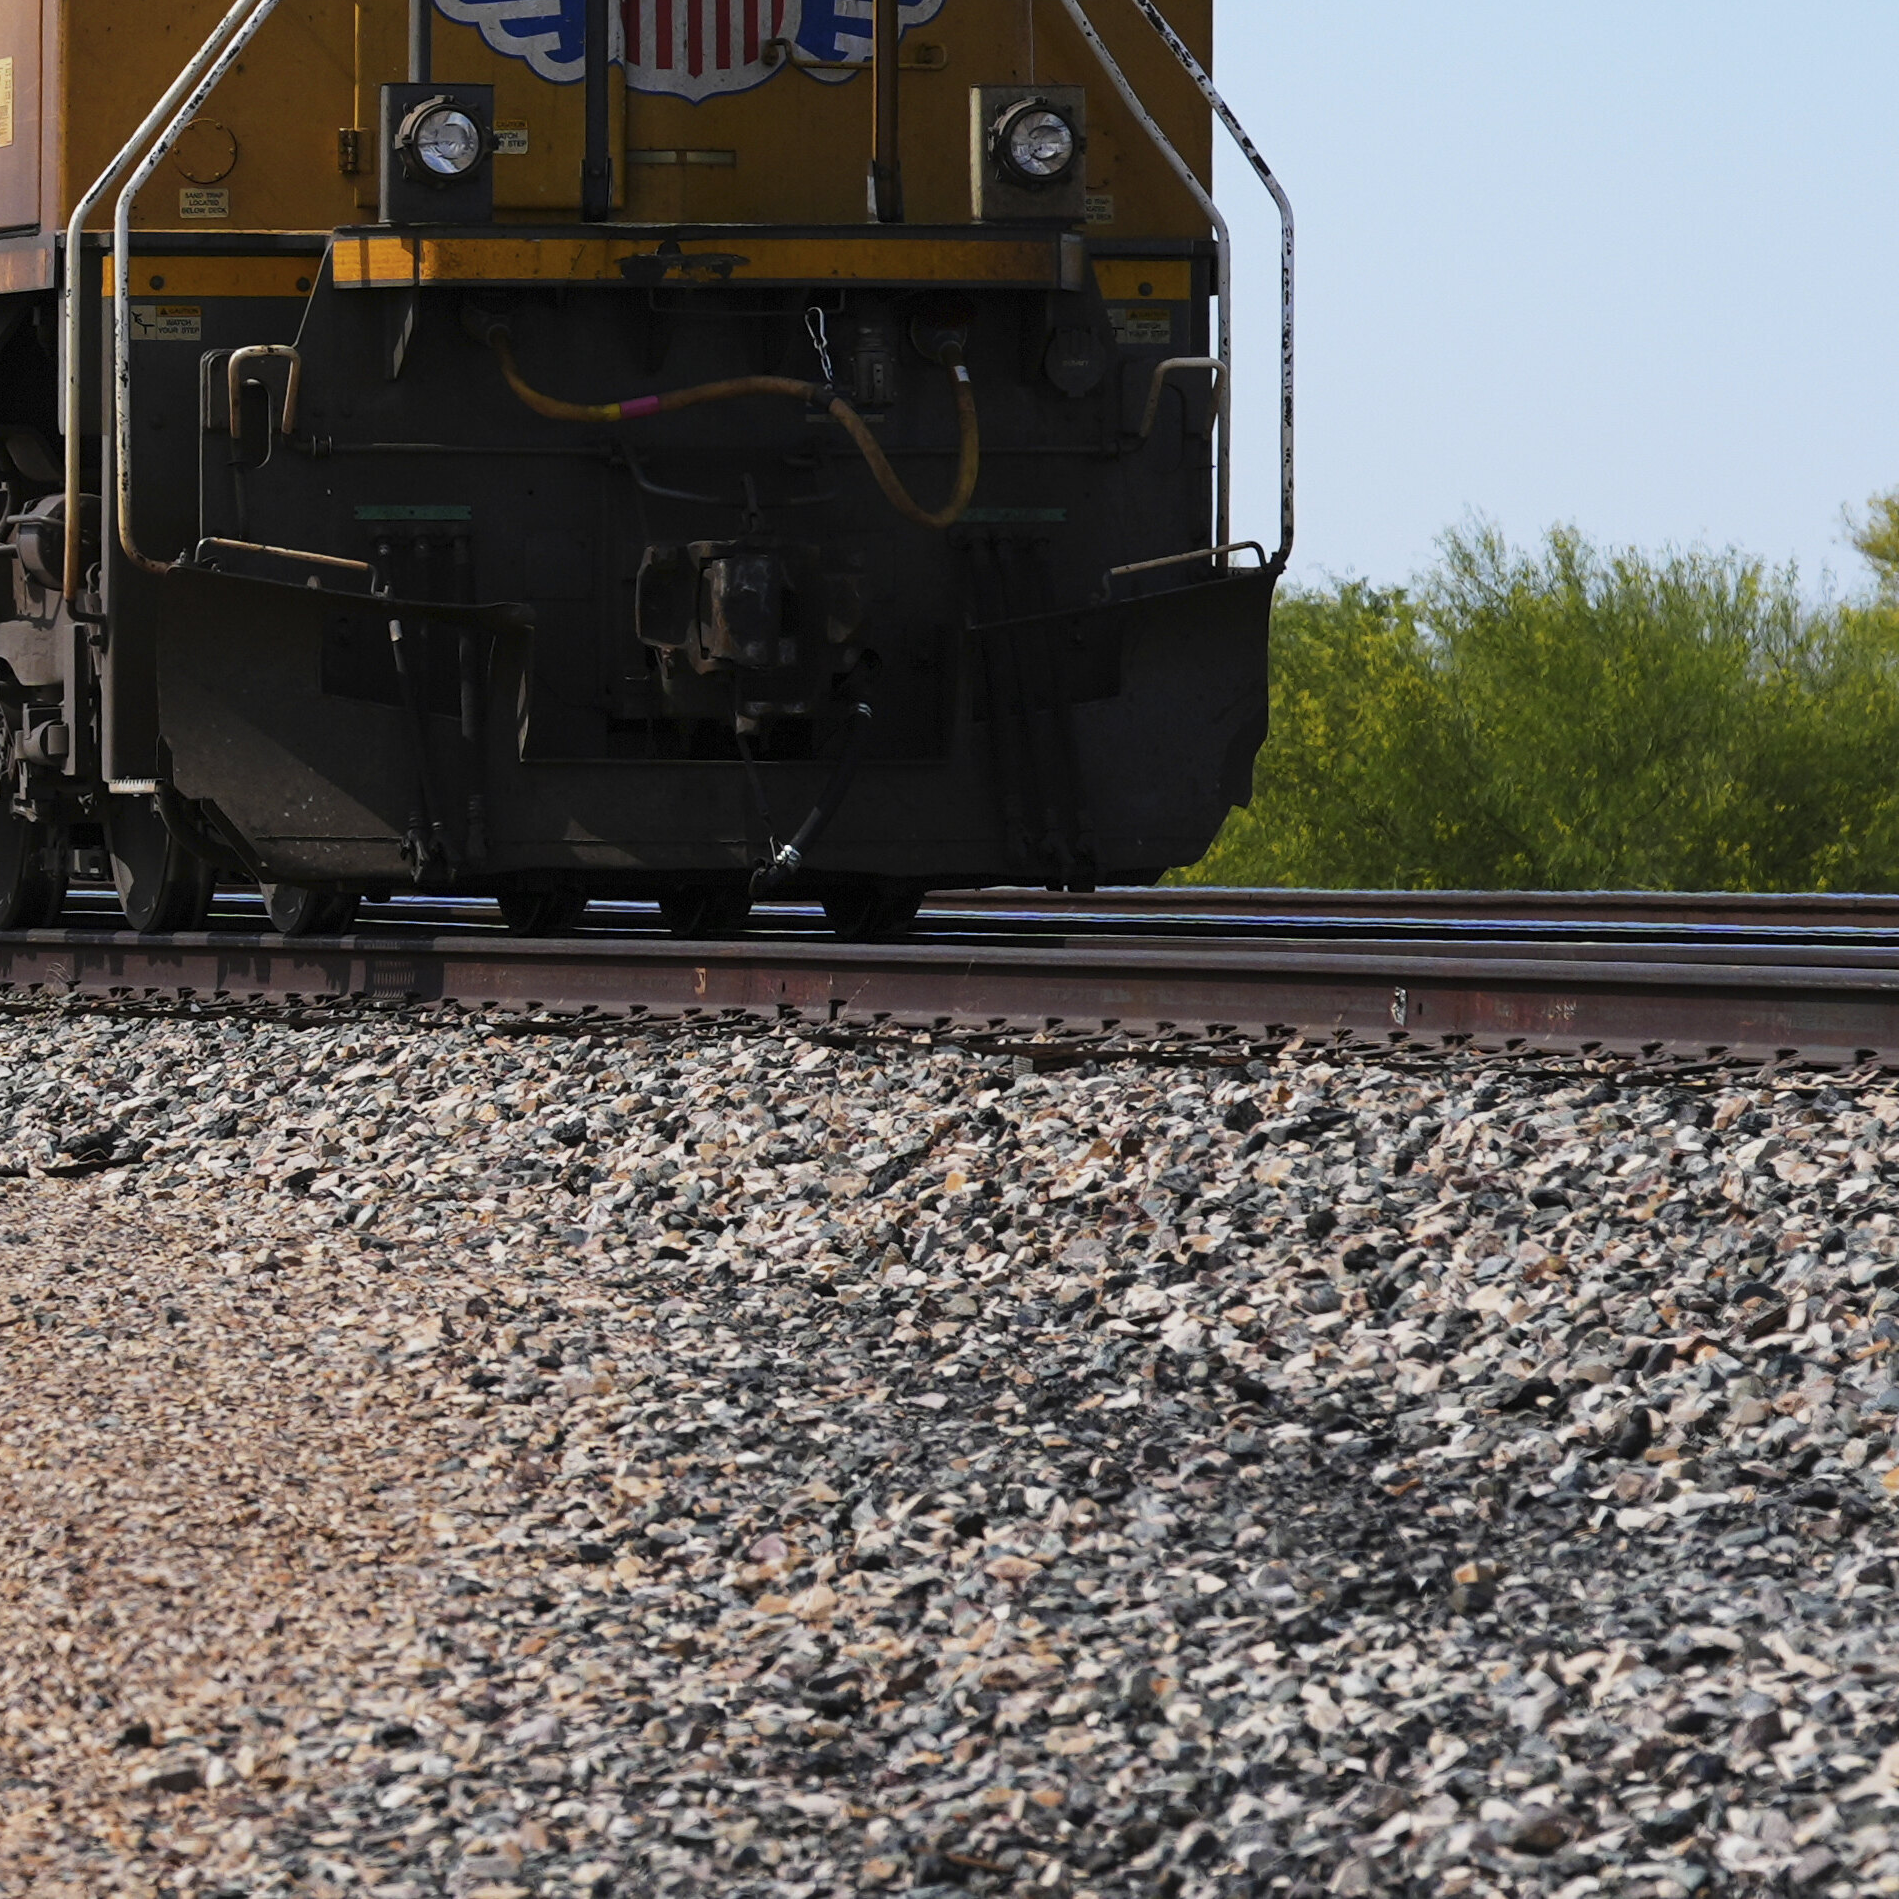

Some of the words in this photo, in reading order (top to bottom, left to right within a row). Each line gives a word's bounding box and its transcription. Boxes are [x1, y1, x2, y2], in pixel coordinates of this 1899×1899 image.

[189, 199, 220, 207] LOCATED
[181, 207, 206, 215] BELOW
[208, 207, 227, 215] DECK
[168, 307, 199, 315] CAUTION
[166, 318, 192, 326] WATCH
[158, 326, 179, 334] YOUR
[181, 326, 200, 335] STEP
